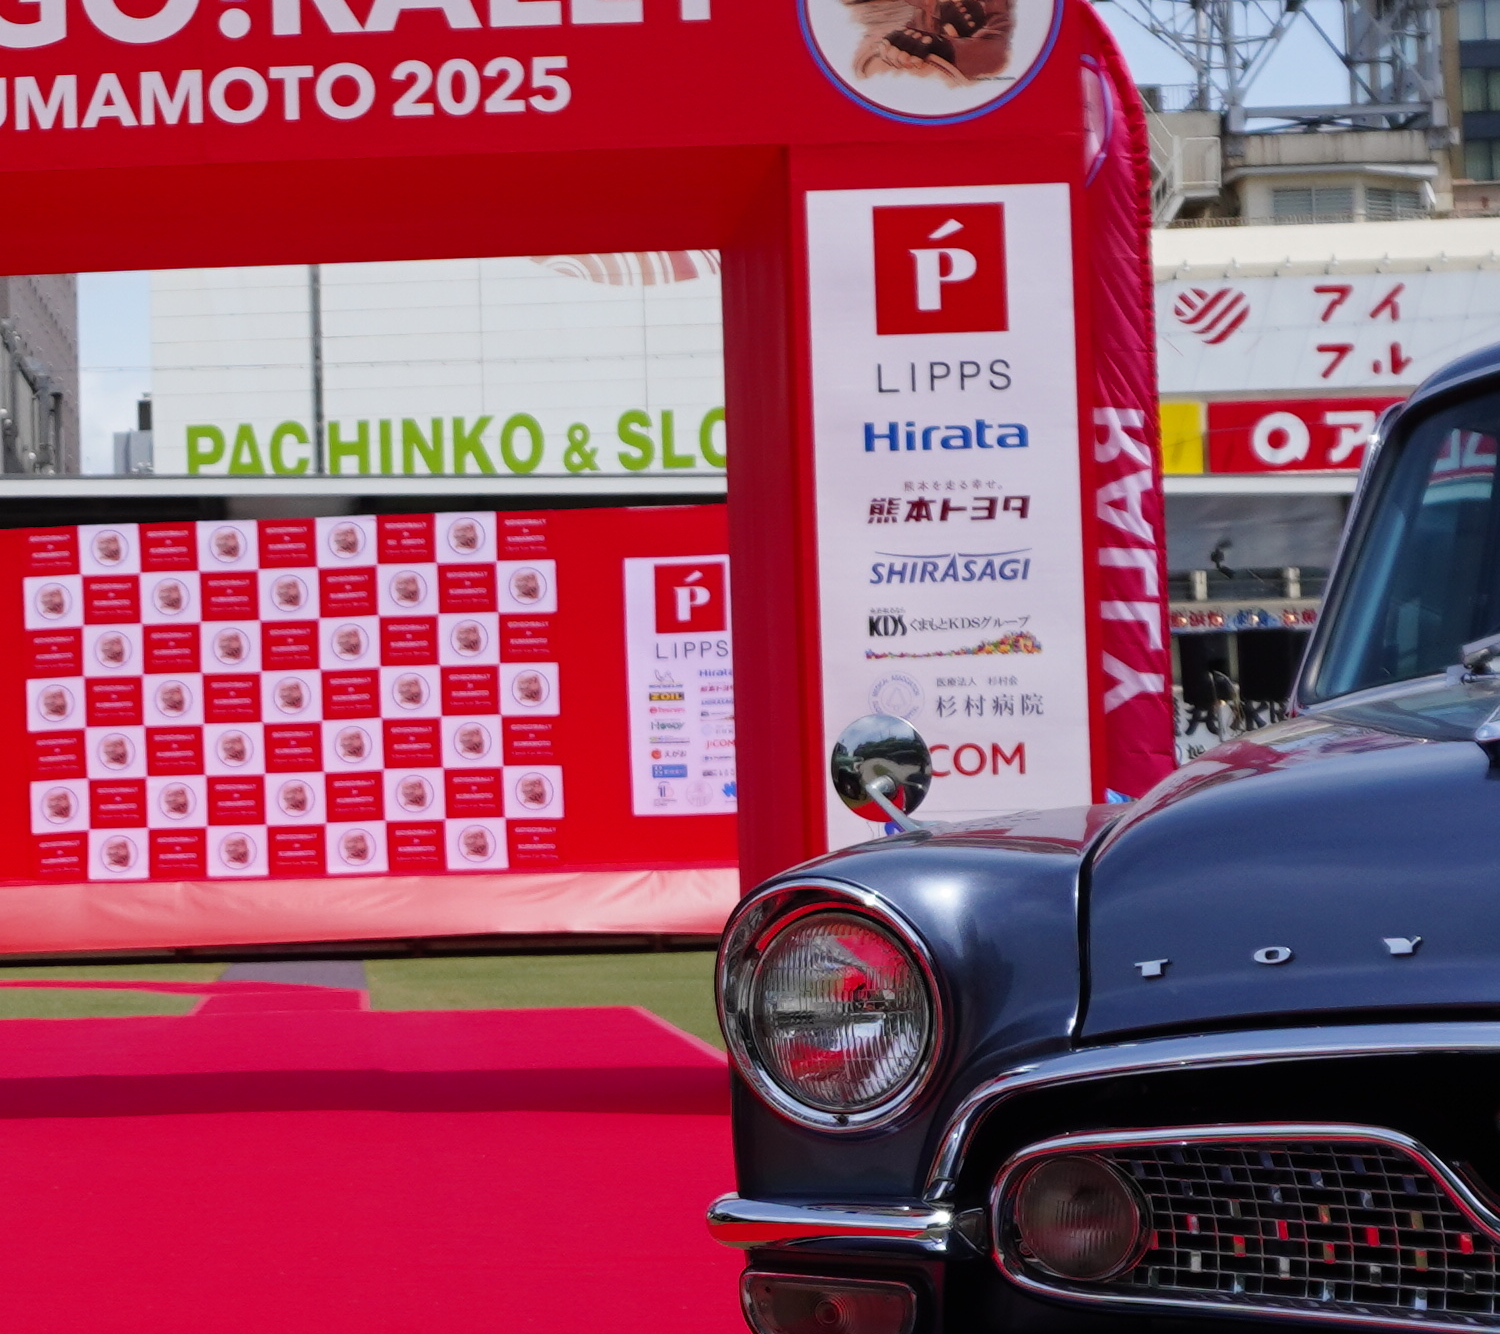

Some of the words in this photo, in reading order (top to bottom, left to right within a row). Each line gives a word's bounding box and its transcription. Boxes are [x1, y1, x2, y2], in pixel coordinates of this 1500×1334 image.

[391, 55, 572, 118] 2025
[876, 358, 1012, 394] LIPPS
[184, 411, 546, 476] PACHINKO
[562, 422, 600, 473] &
[863, 418, 1030, 453] Hirata
[867, 494, 1031, 525] 熊本トヨタ
[869, 553, 1032, 585] SHIRASAGI
[868, 615, 908, 637] KDS
[655, 640, 729, 660] LIPPS
[935, 692, 1045, 718] 杉村病院
